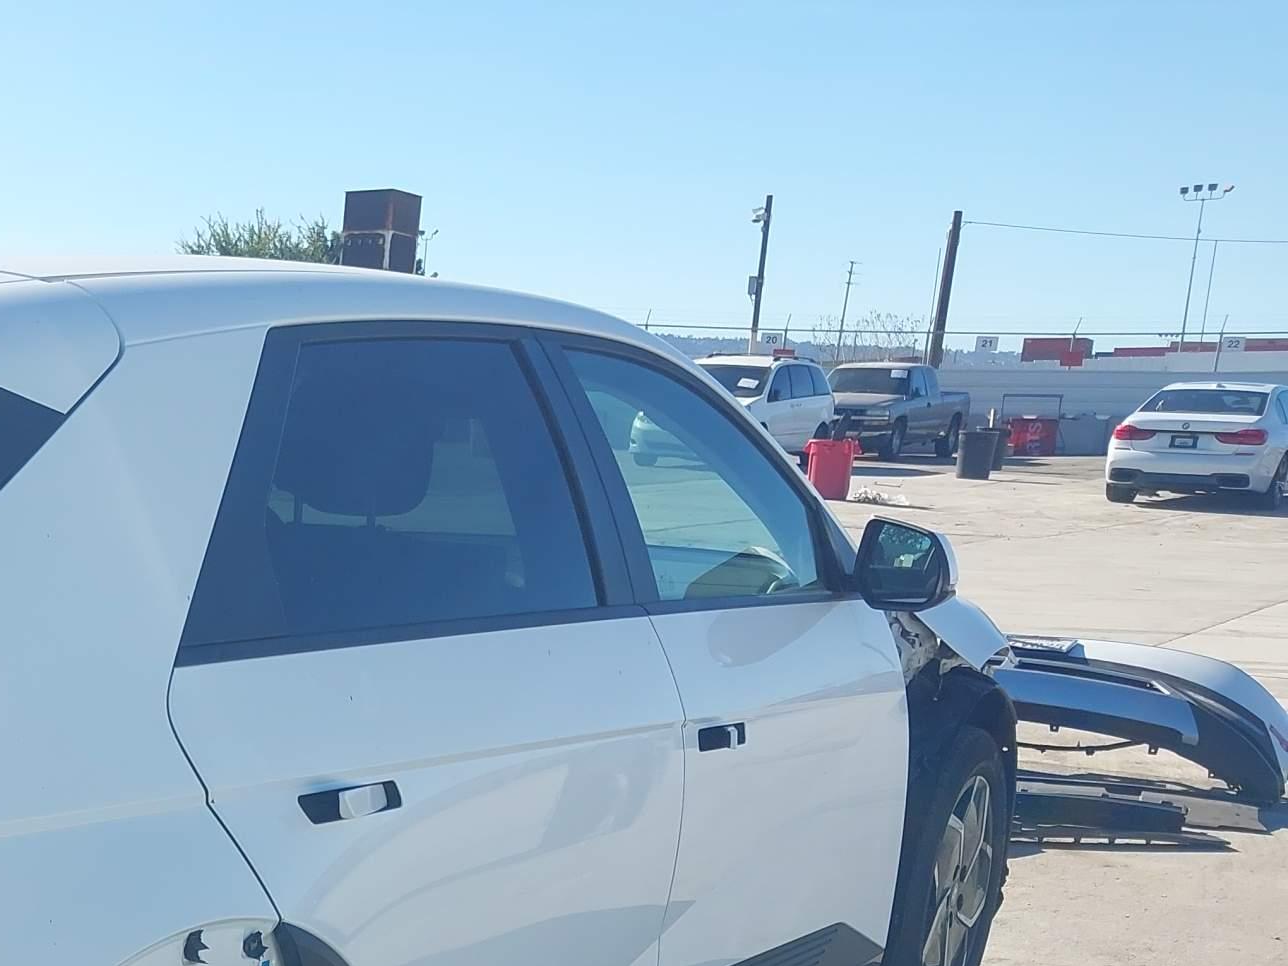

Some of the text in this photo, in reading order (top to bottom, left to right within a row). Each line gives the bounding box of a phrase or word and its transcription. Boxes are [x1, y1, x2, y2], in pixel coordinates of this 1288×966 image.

[766, 336, 778, 345] 20
[981, 340, 993, 348] 21
[1227, 339, 1241, 349] 22
